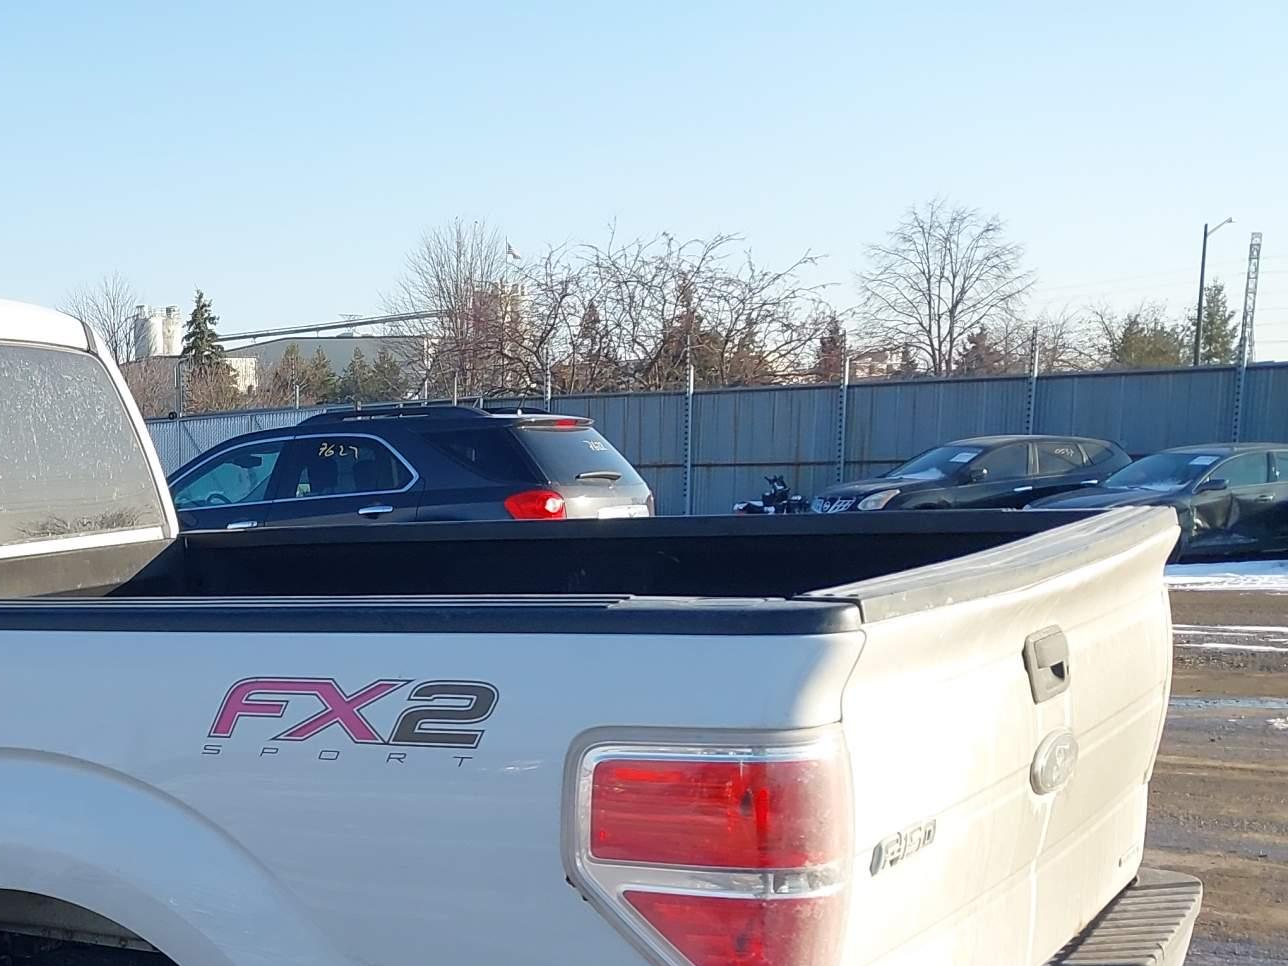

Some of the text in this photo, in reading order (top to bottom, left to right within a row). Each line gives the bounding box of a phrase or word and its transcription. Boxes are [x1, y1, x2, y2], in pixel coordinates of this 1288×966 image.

[318, 442, 358, 462] 7627
[207, 677, 500, 749] FX2
[201, 744, 473, 767] SPORT
